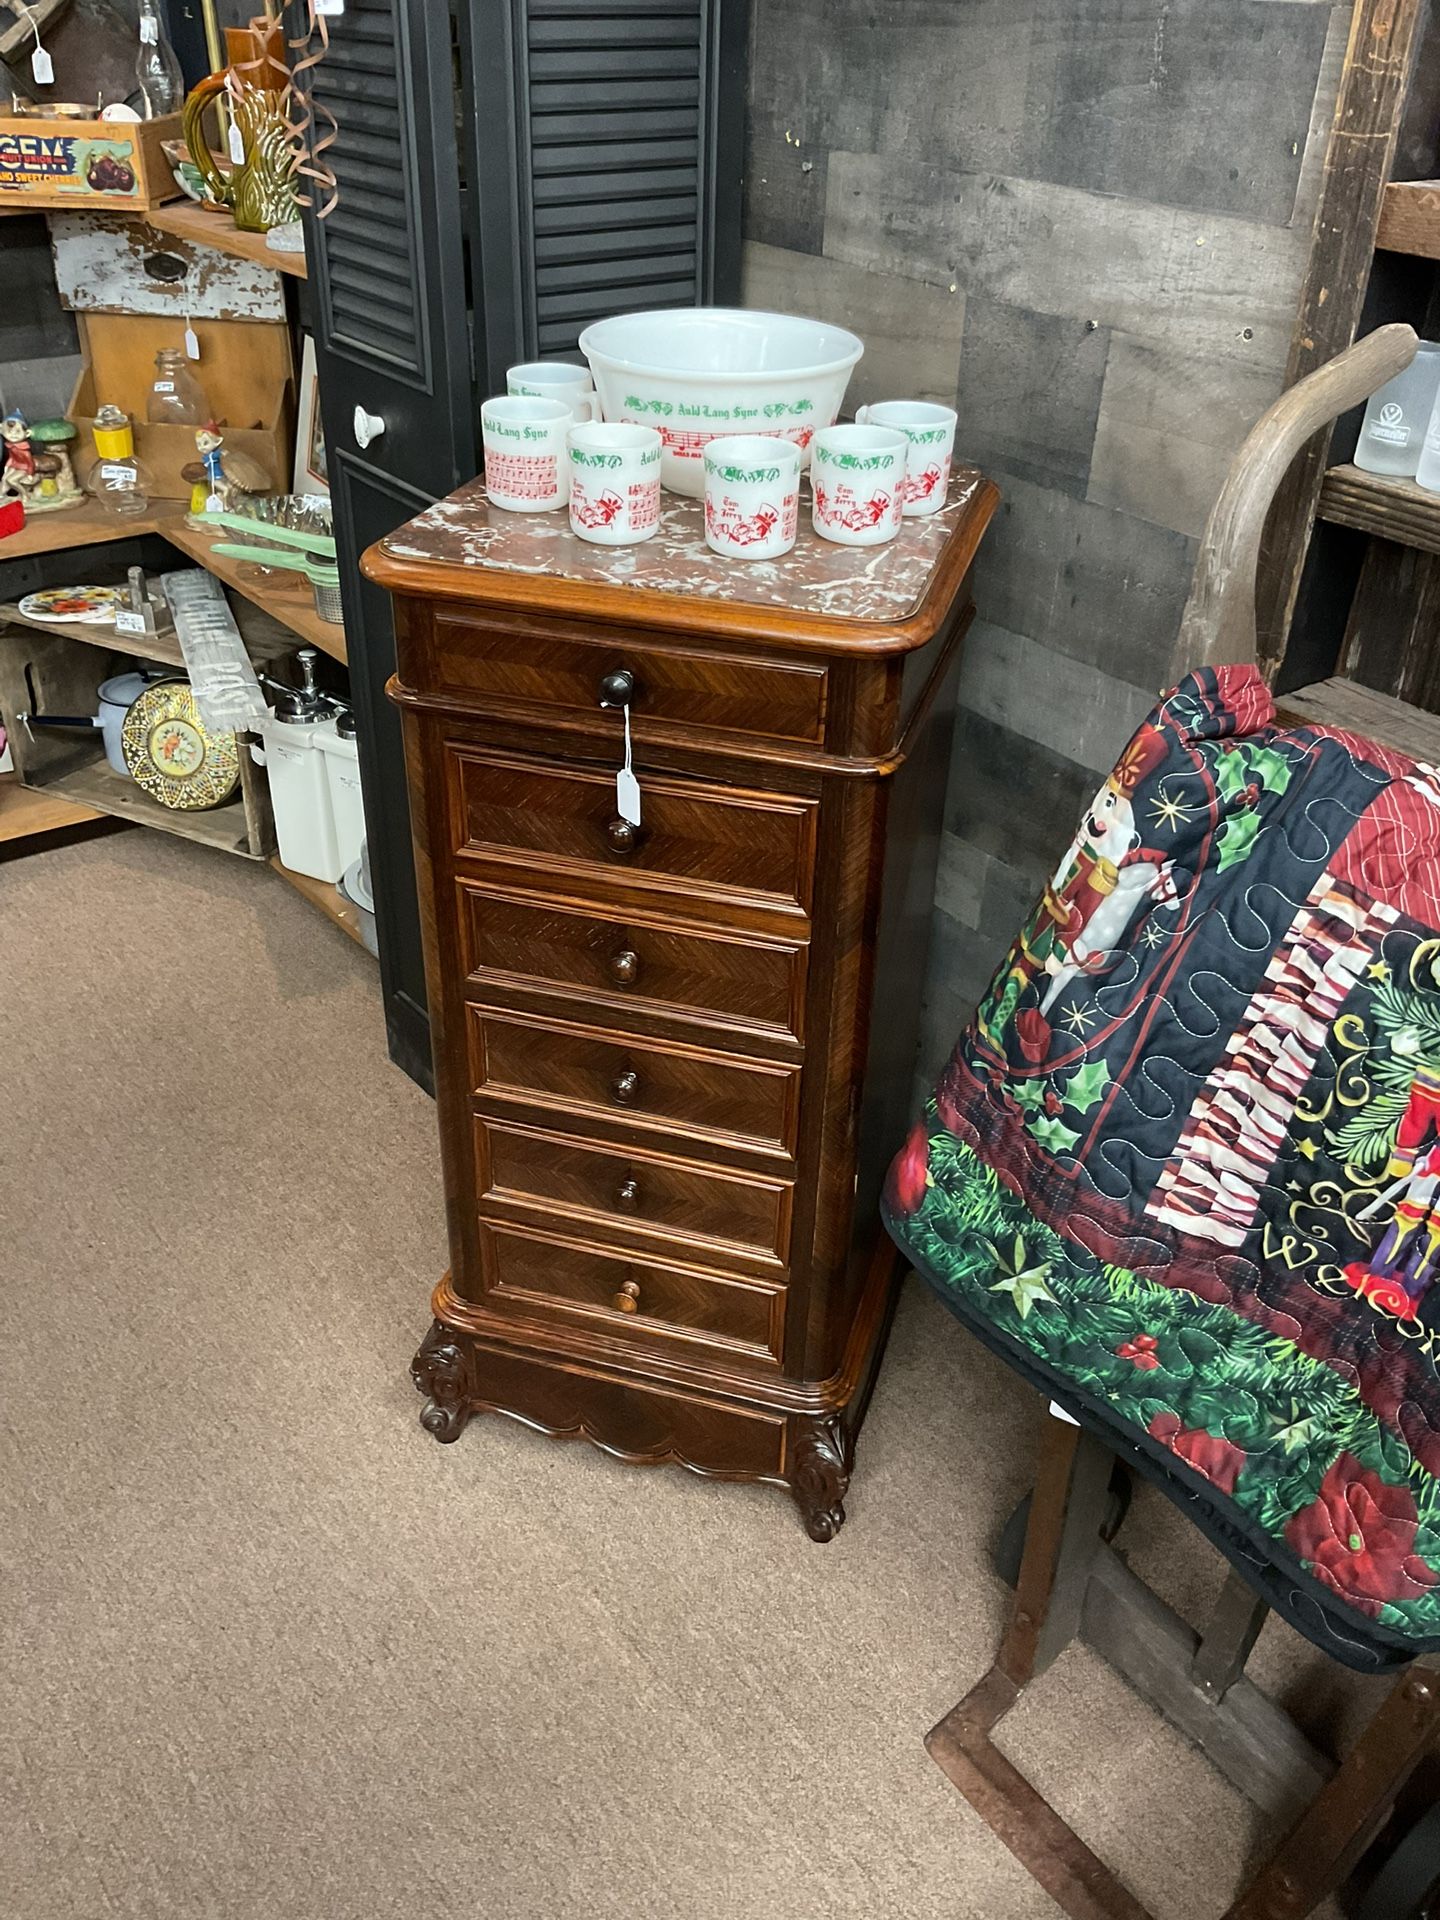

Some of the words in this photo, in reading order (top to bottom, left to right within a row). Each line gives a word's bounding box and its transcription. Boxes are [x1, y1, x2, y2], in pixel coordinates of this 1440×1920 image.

[15, 172, 43, 183] SWEET
[678, 403, 701, 417] Auld
[702, 405, 730, 420] Lang
[732, 406, 758, 419] Syne
[497, 422, 520, 440] Lang
[523, 426, 549, 441] Syne
[640, 450, 657, 465] Auld
[836, 484, 854, 495] Tom
[723, 496, 739, 507] Tom
[834, 495, 856, 508] Jerry
[720, 508, 742, 521] Jerry
[199, 662, 258, 717] POST
